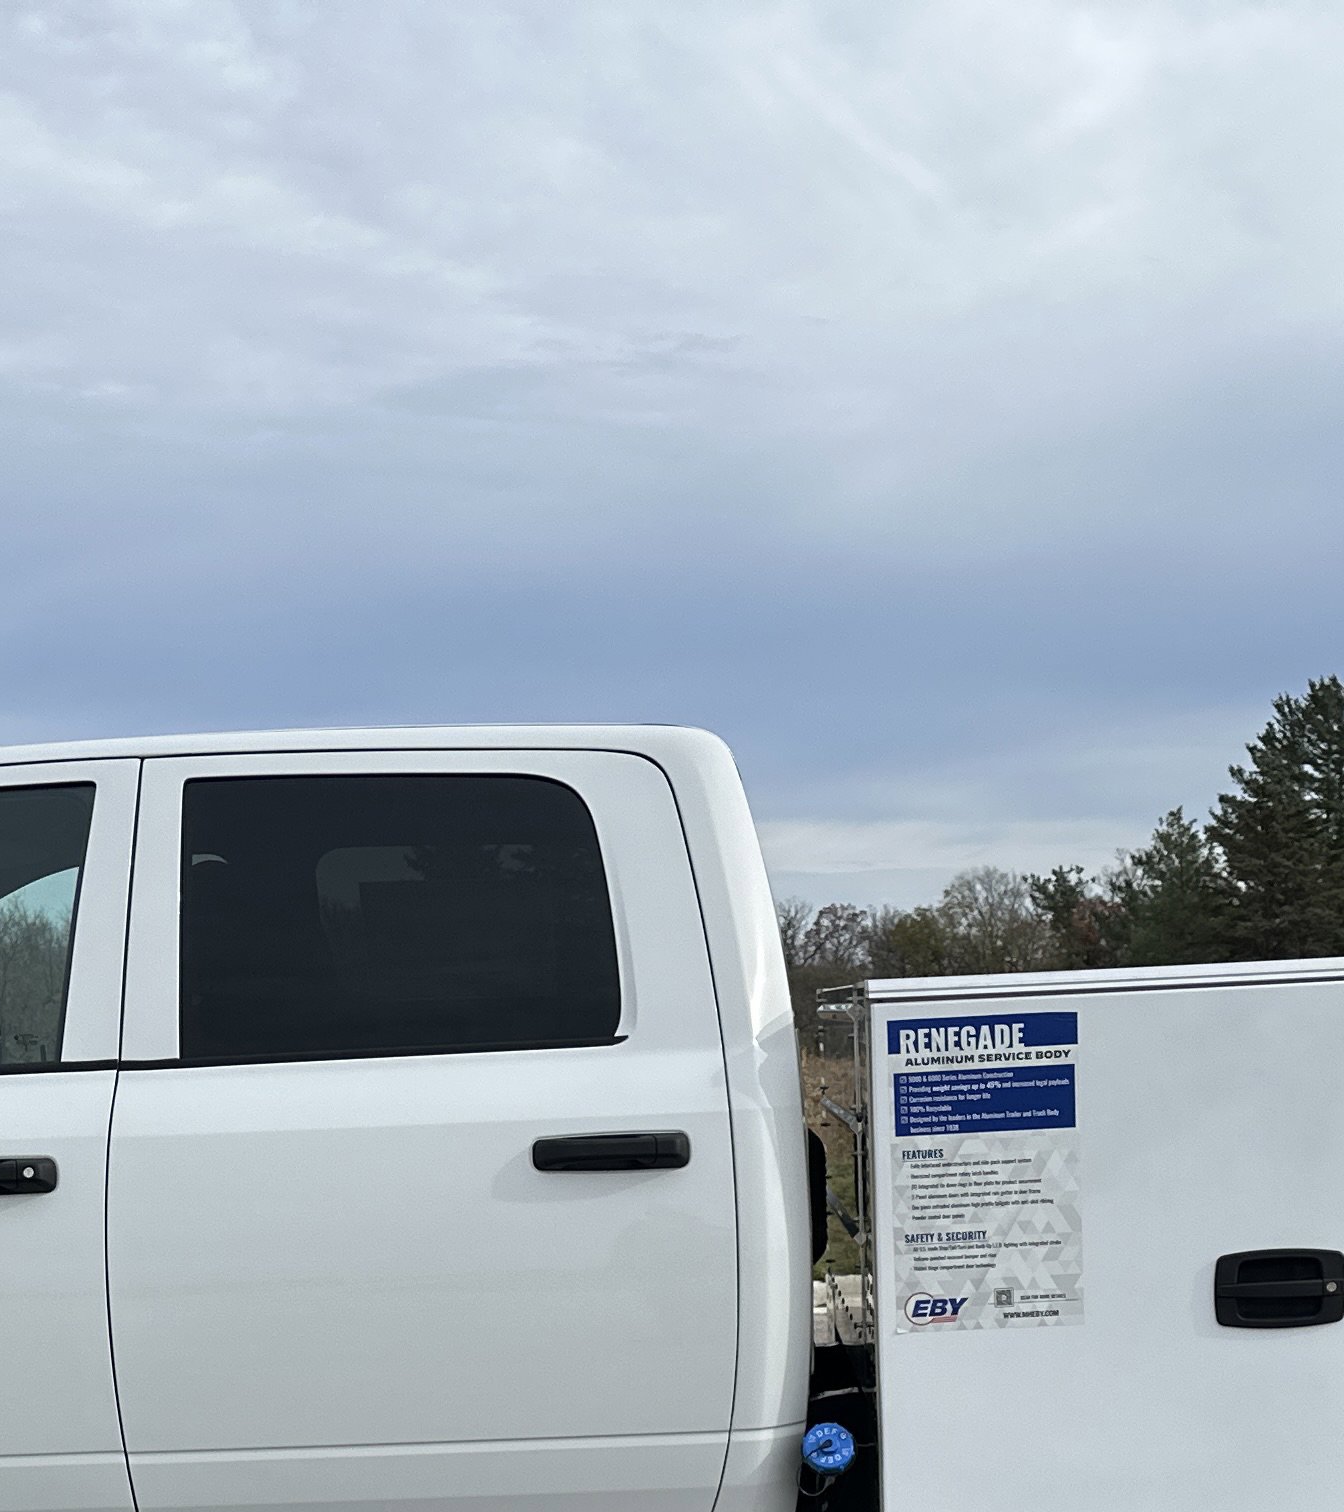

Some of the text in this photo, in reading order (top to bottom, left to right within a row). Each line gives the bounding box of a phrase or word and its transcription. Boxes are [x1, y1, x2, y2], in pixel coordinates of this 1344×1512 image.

[899, 1023, 1025, 1055] RENEGADE
[905, 1050, 1071, 1067] ALUMINUM SERVICE BODY
[902, 1149, 944, 1161] FEATURES
[905, 1231, 987, 1243] SAFETY & SECURITY
[912, 1297, 968, 1318] EBY
[816, 1427, 838, 1438] DEF
